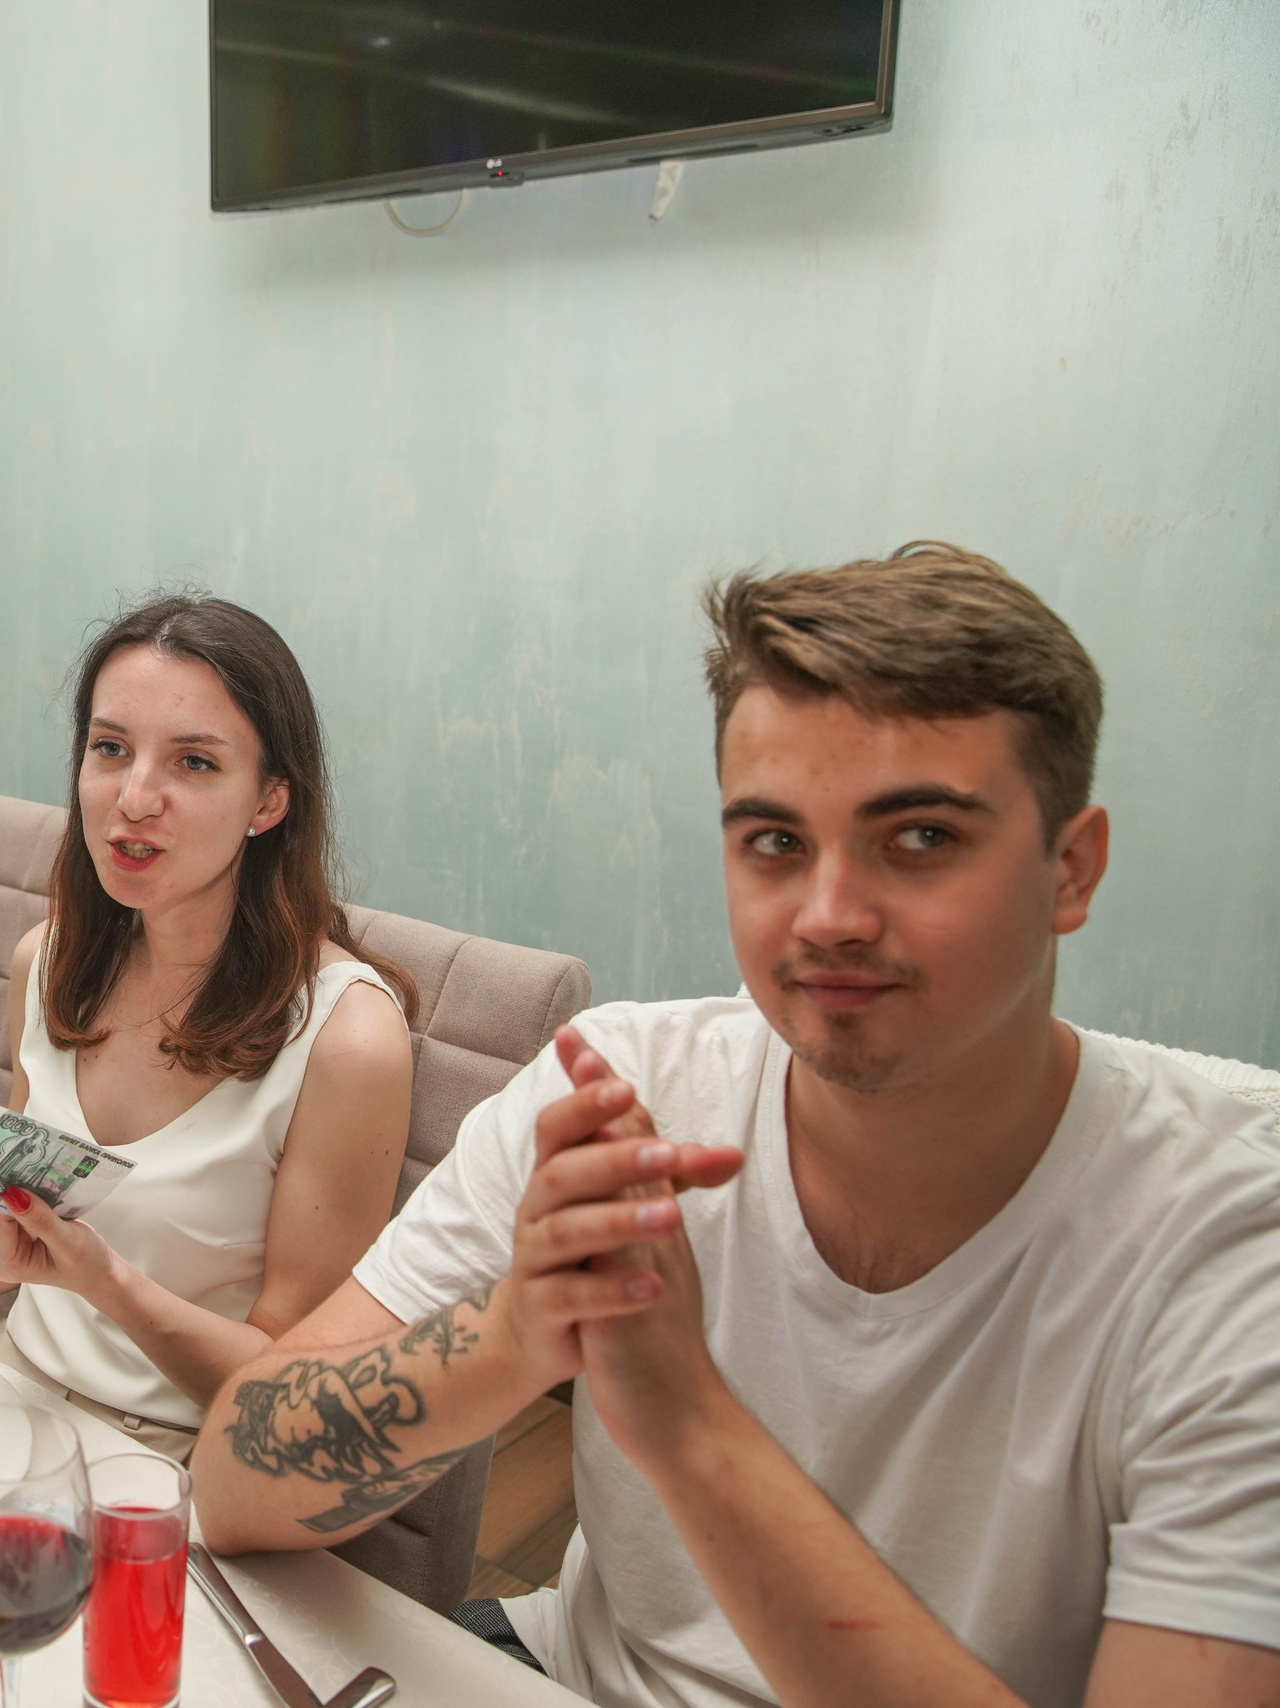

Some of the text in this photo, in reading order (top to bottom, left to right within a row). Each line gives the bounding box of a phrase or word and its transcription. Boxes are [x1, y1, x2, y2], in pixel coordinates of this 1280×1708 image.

[58, 1134, 81, 1146] БИЛЕТ
[78, 1142, 101, 1156] БАНКА
[100, 1152, 135, 1169] ПРИКОЛОВ
